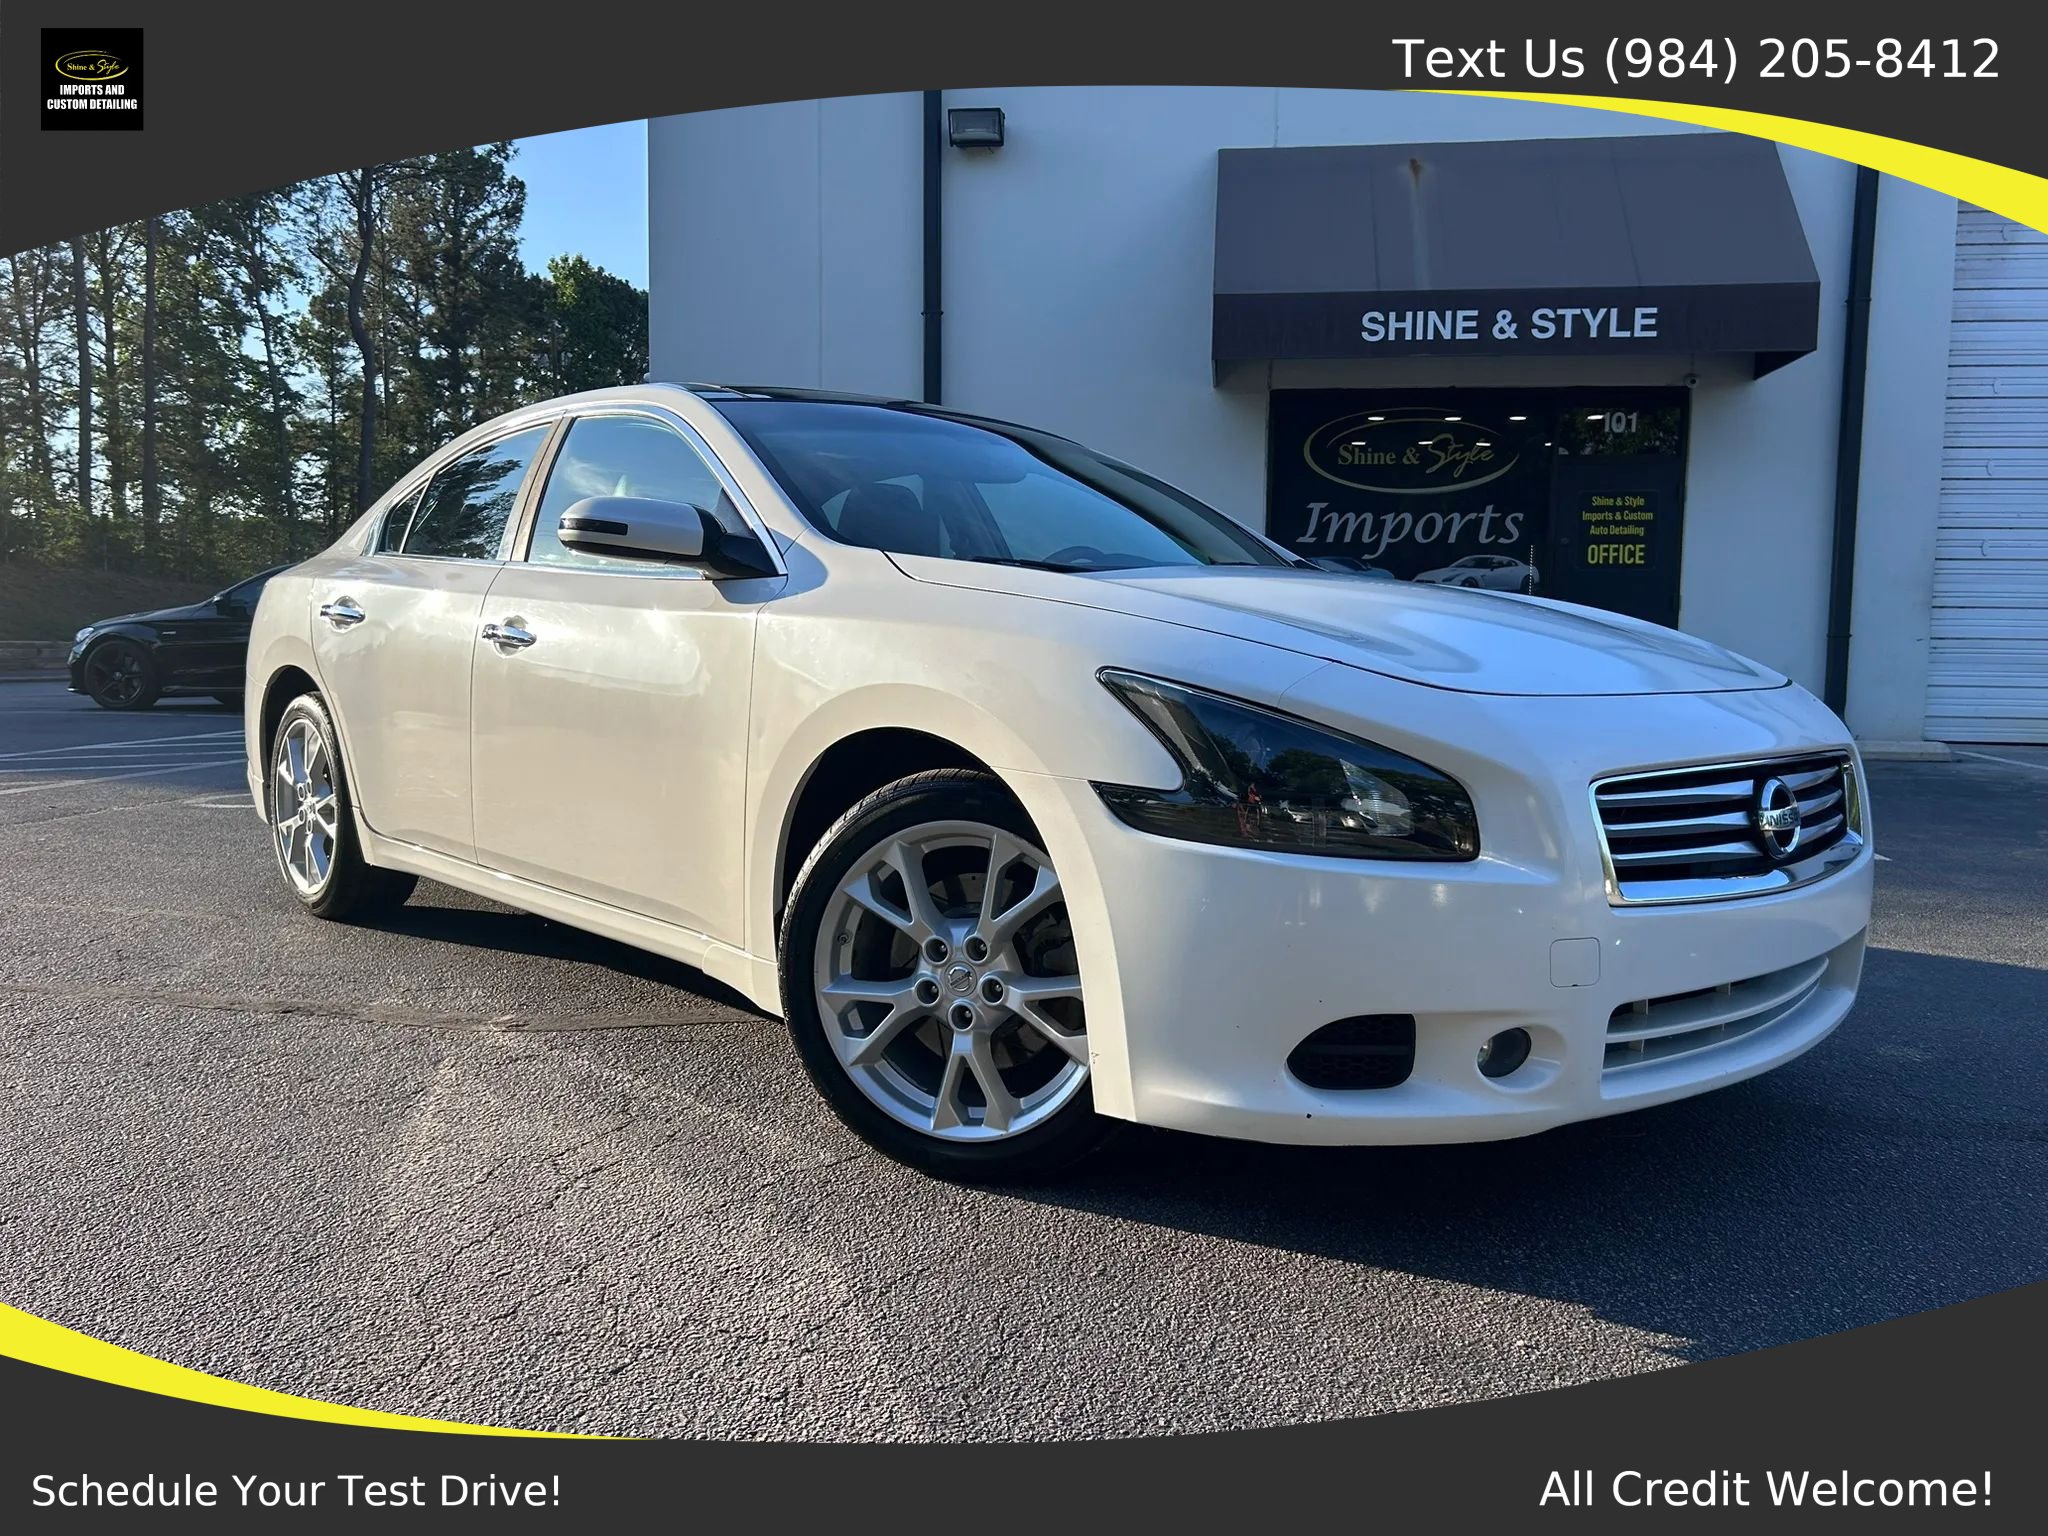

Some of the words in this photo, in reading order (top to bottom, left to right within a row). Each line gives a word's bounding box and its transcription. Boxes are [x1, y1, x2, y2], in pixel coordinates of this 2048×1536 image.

[1361, 309, 1479, 342] SHINE
[1492, 309, 1518, 340] &
[1531, 306, 1658, 339] STYLE
[1604, 411, 1638, 433] 101
[1337, 443, 1397, 466] Shine
[1402, 449, 1420, 466] &
[1424, 433, 1495, 479] Style
[1591, 496, 1614, 507] Shine
[1615, 497, 1622, 506] &
[1624, 496, 1645, 507] Style
[1582, 511, 1614, 521] Imports
[1615, 511, 1622, 520] &
[1623, 510, 1654, 521] Custom
[1296, 502, 1525, 560] Imports
[1589, 525, 1609, 536] Auto
[1609, 525, 1645, 536] Detailing
[1587, 544, 1646, 565] OFFICE
[1766, 807, 1799, 827] NISS
